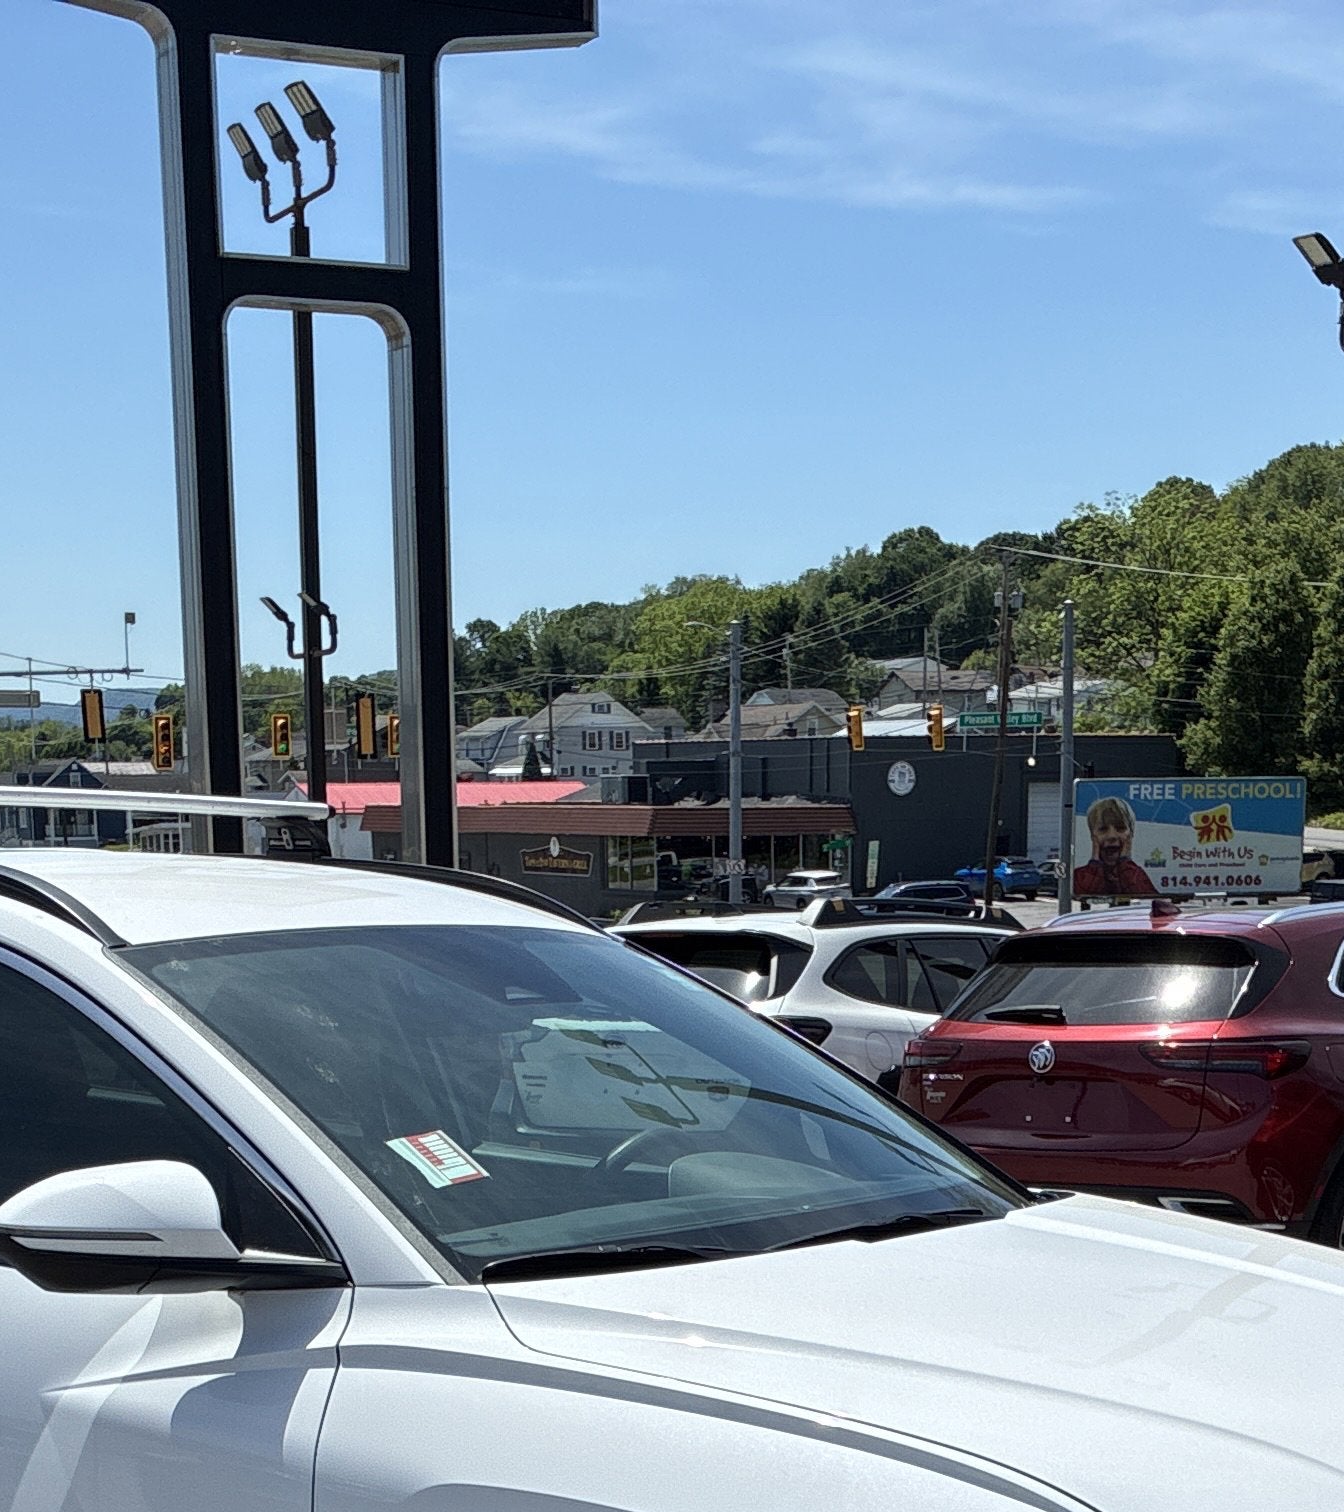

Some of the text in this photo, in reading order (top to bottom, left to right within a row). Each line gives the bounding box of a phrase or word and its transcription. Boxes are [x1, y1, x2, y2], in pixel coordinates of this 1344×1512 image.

[964, 715, 995, 724] Pleasant
[1129, 783, 1301, 800] FREE PRESCHOOL!
[1171, 846, 1254, 861] Begin With Us
[1160, 875, 1262, 887] 814.941.0606
